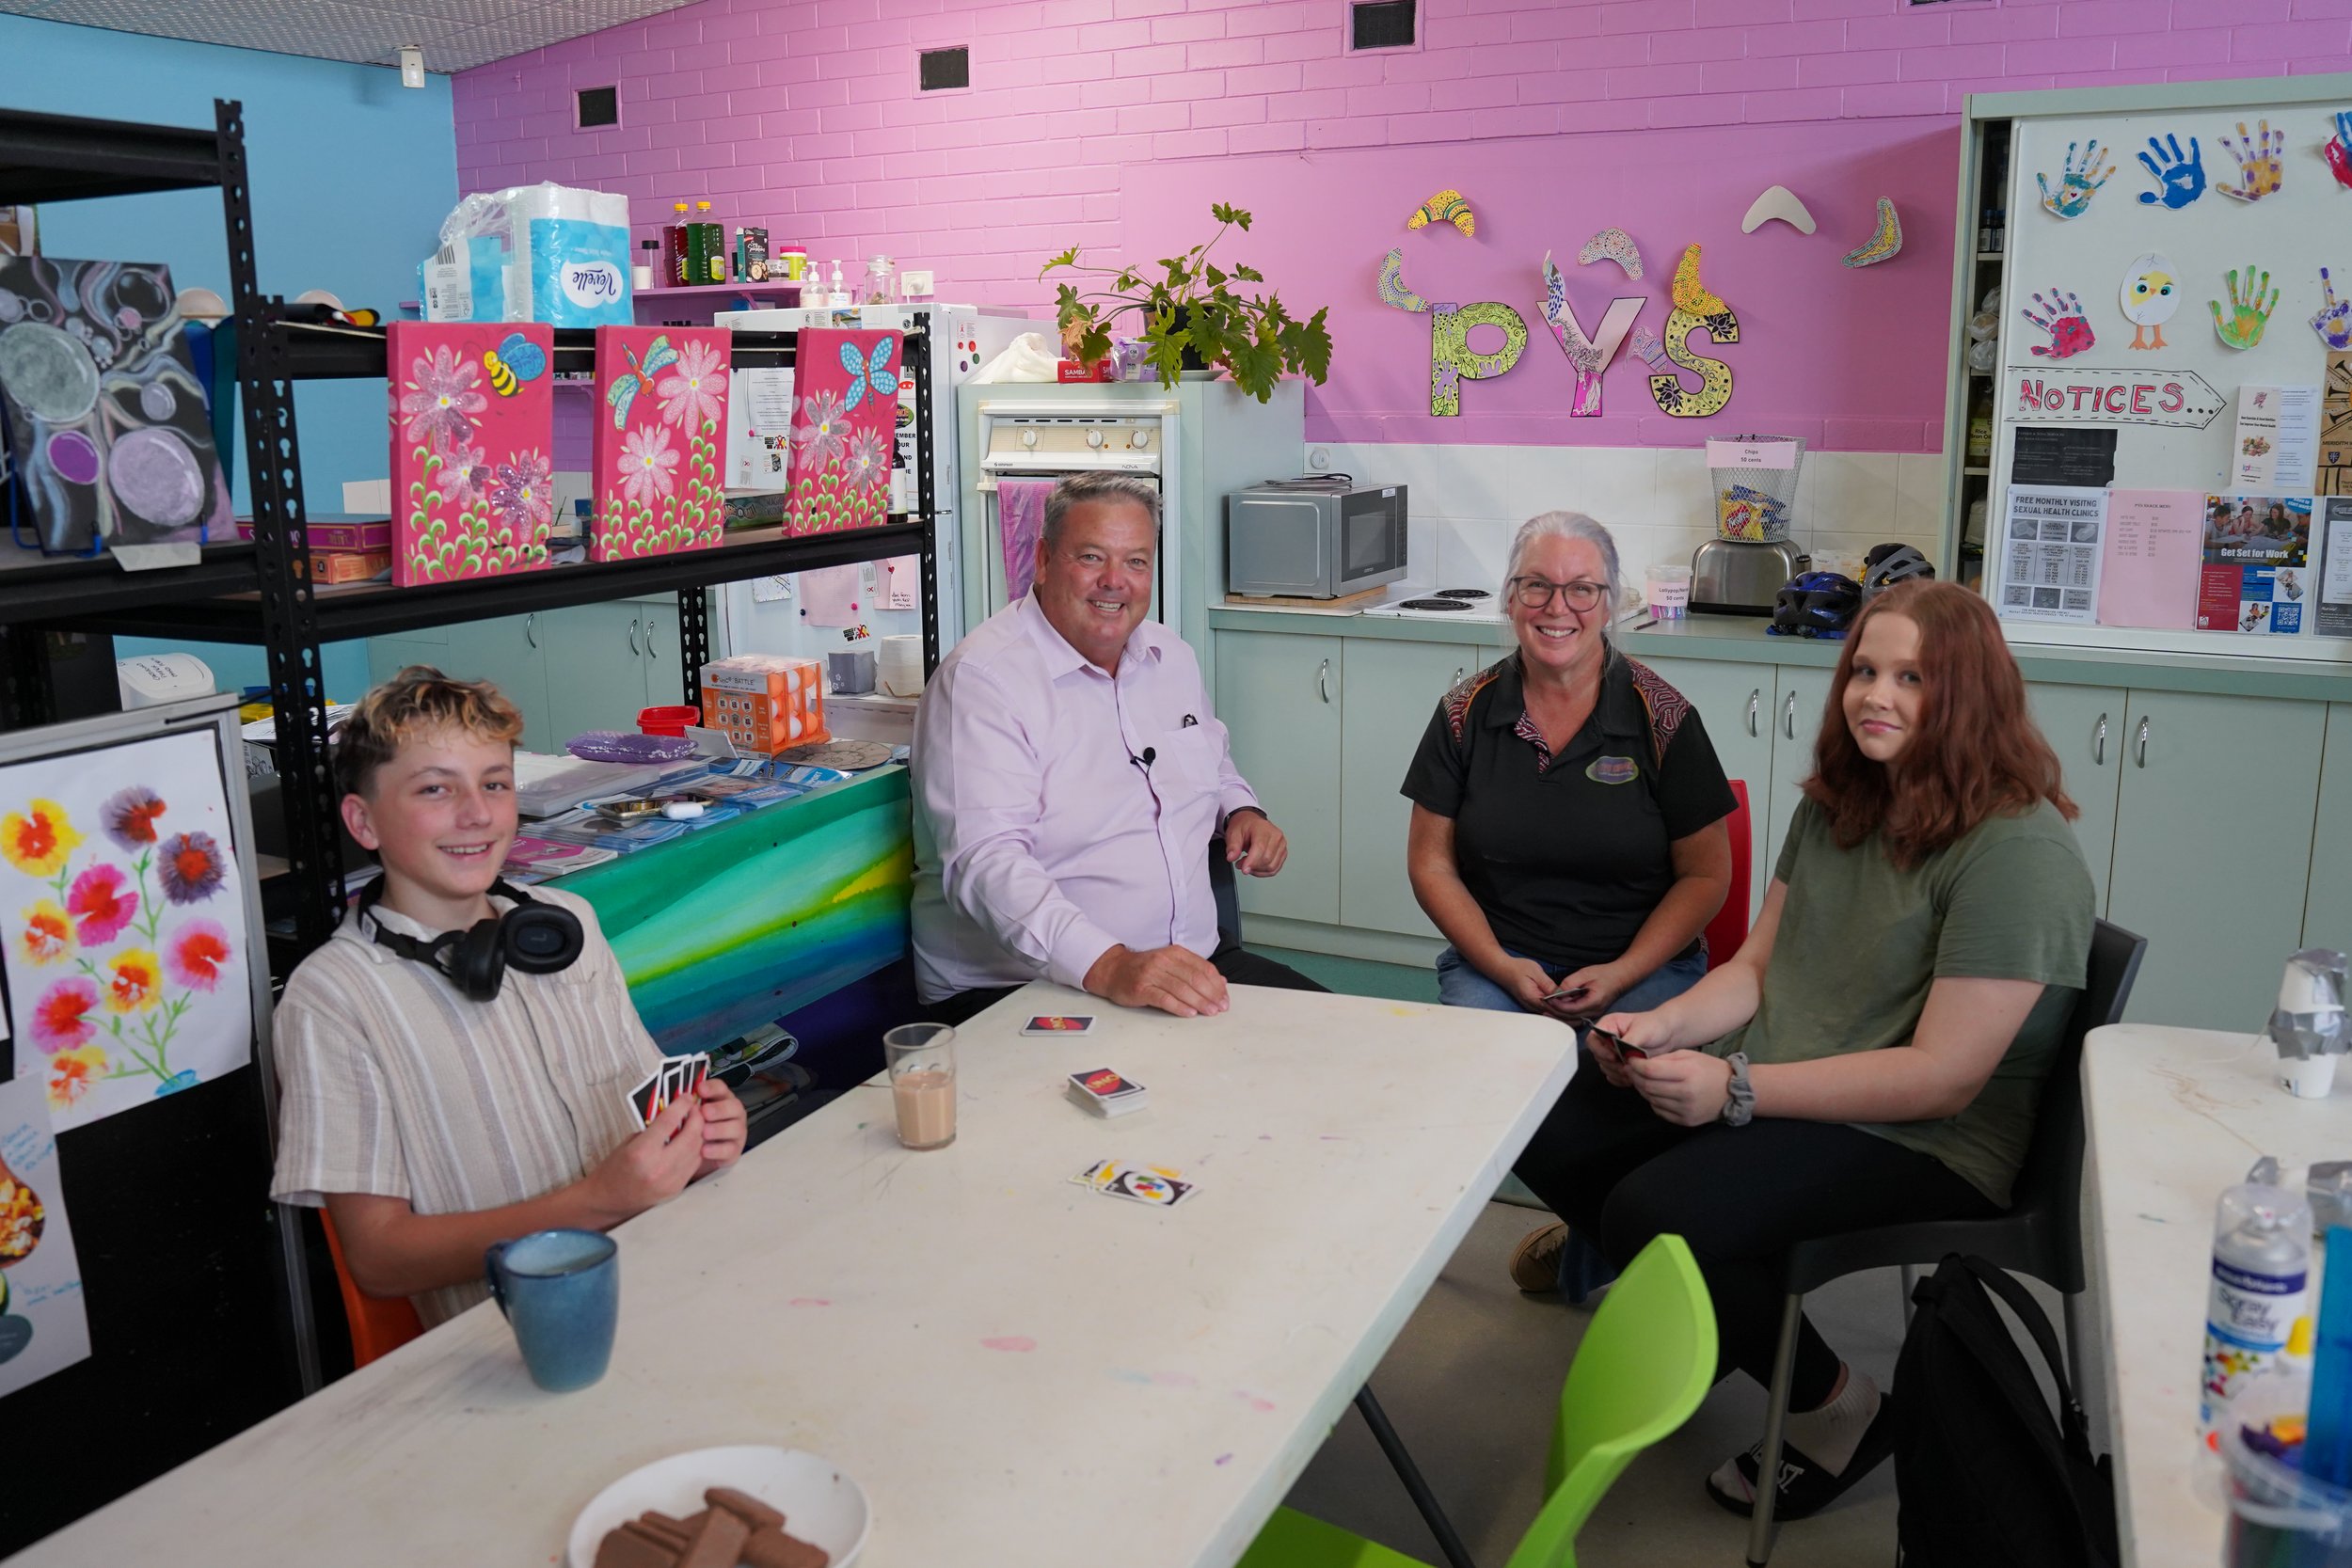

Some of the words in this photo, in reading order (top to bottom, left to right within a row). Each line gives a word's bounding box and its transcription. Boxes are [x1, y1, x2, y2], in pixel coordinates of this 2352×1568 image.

[1431, 297, 1740, 417] PYS
[2015, 496, 2033, 504] FREE
[2035, 497, 2068, 507] MONTHLY
[2069, 499, 2097, 507] VISITNG
[2013, 505, 2042, 515] SEXUAL
[2042, 508, 2070, 516] HEALTH
[2072, 509, 2099, 517] CLINICS
[2220, 548, 2235, 557] Get
[2236, 548, 2251, 558] Set
[2251, 548, 2265, 558] for
[2265, 549, 2289, 559] Work
